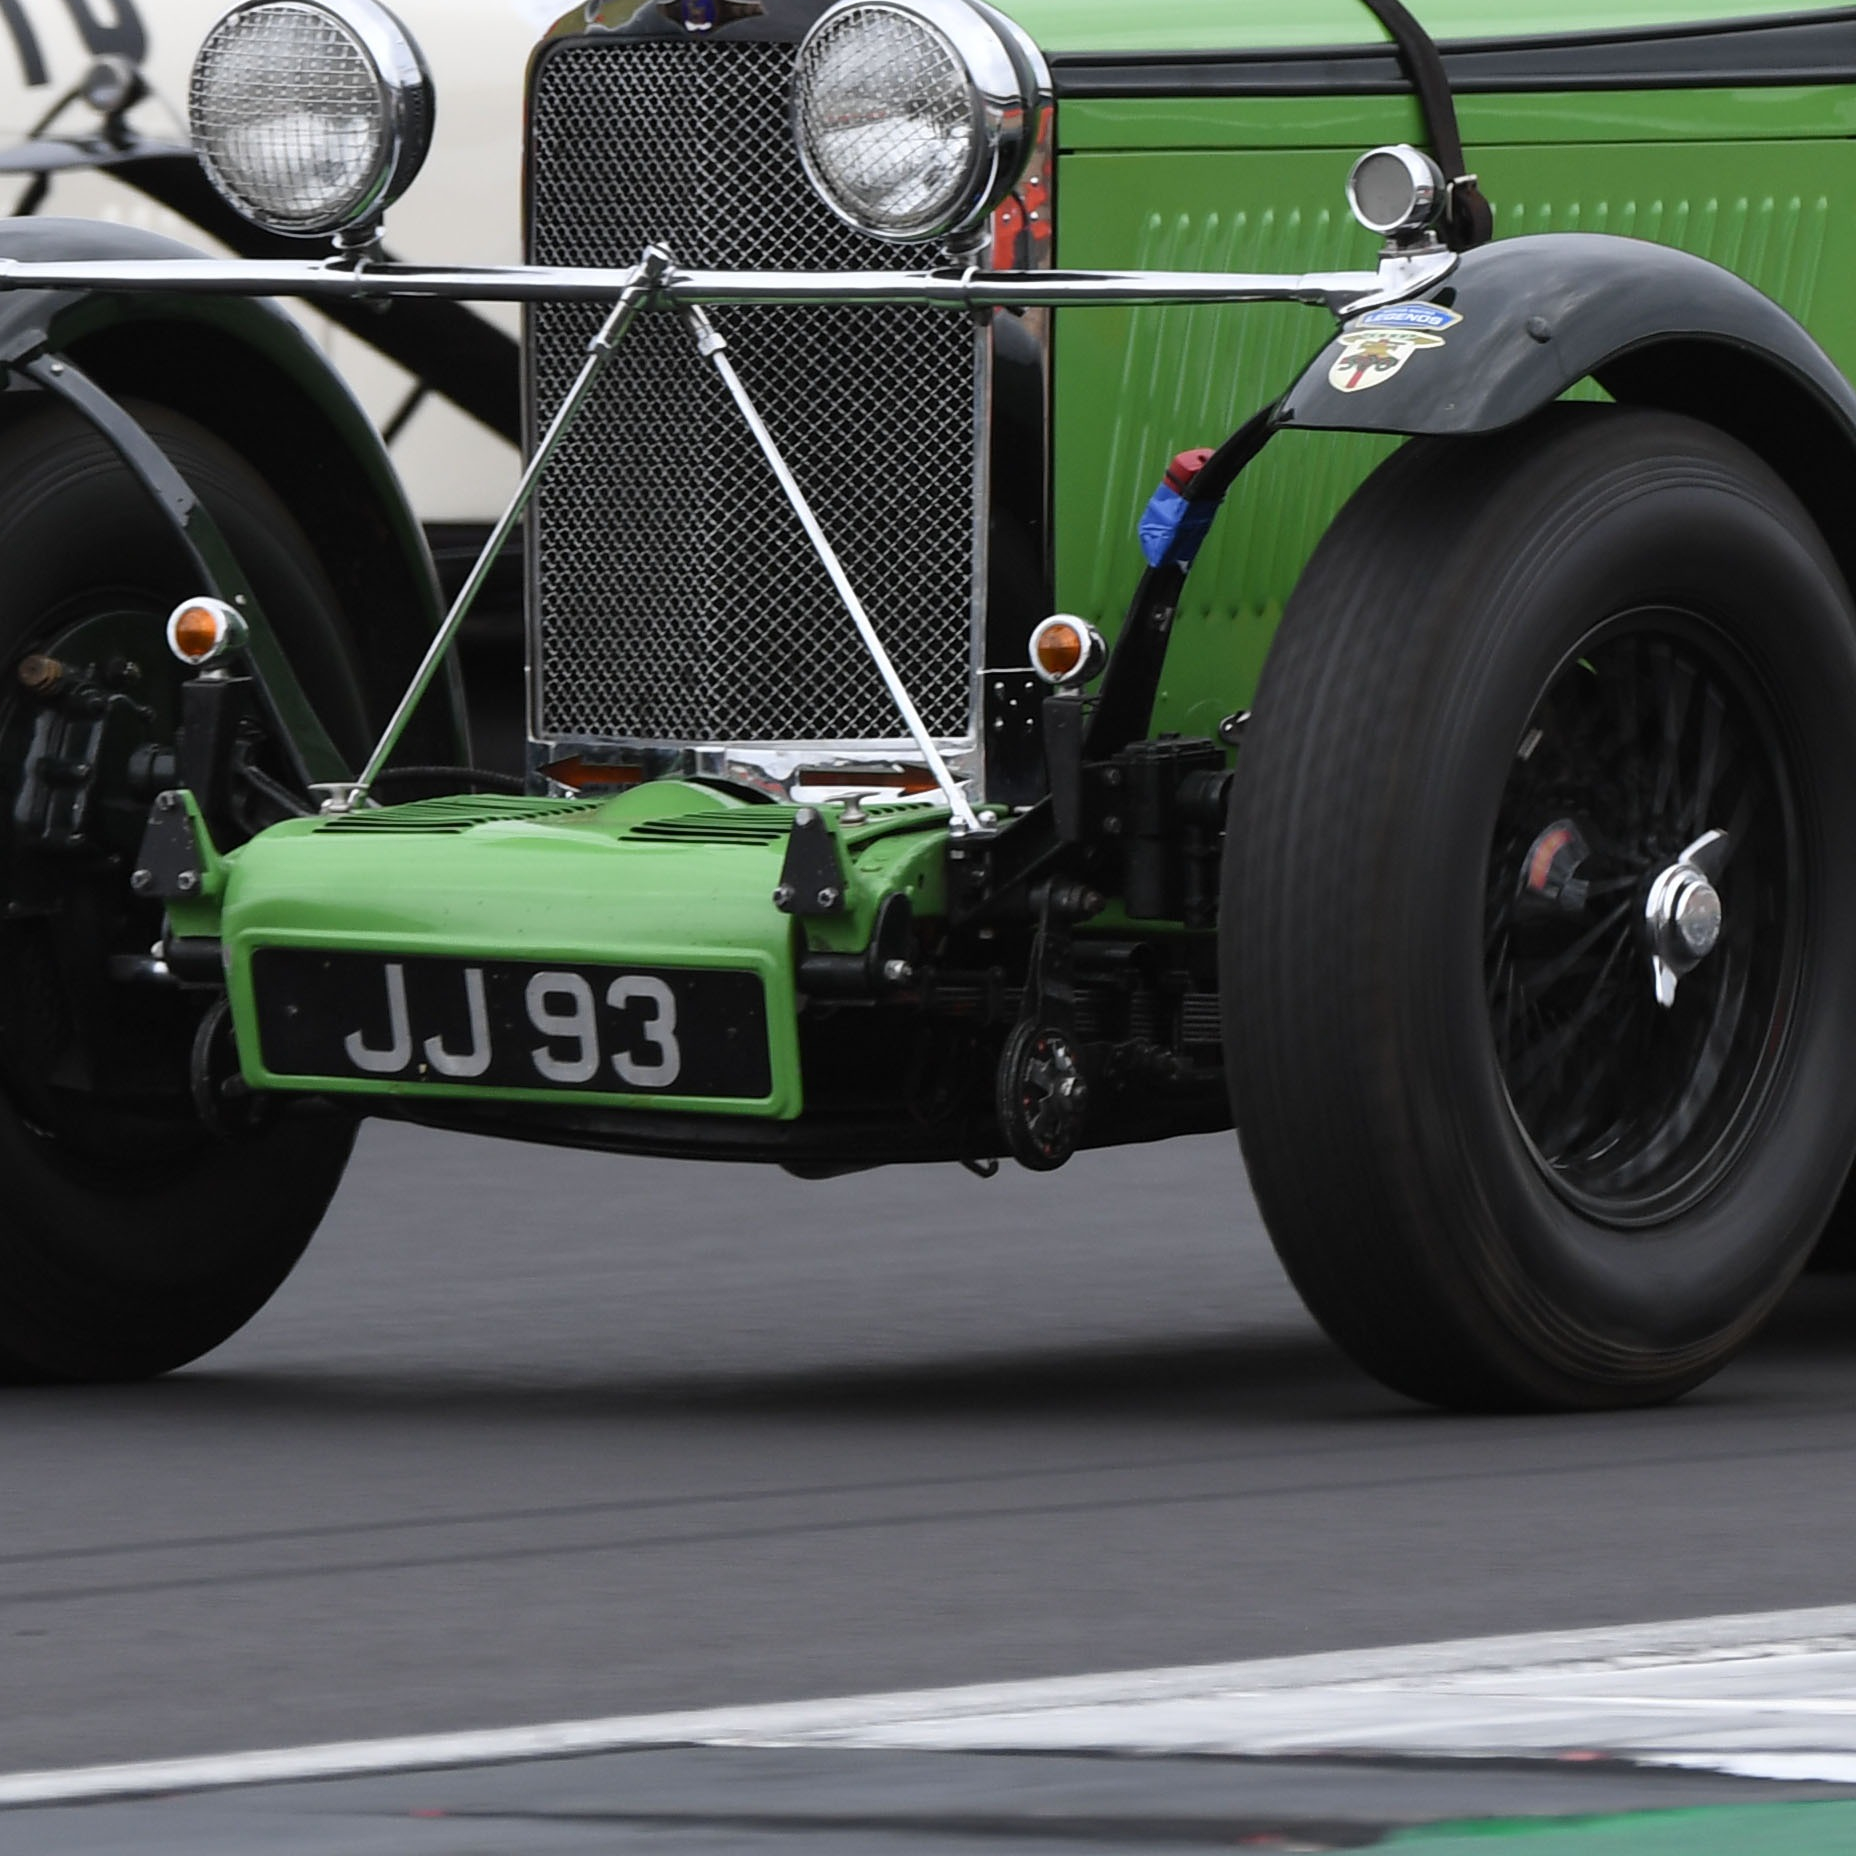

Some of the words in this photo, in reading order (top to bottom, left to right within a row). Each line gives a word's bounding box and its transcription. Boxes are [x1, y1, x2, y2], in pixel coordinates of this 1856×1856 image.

[1364, 312, 1444, 326] LEGENDS
[344, 962, 494, 1077] JJ
[524, 970, 682, 1088] 93
